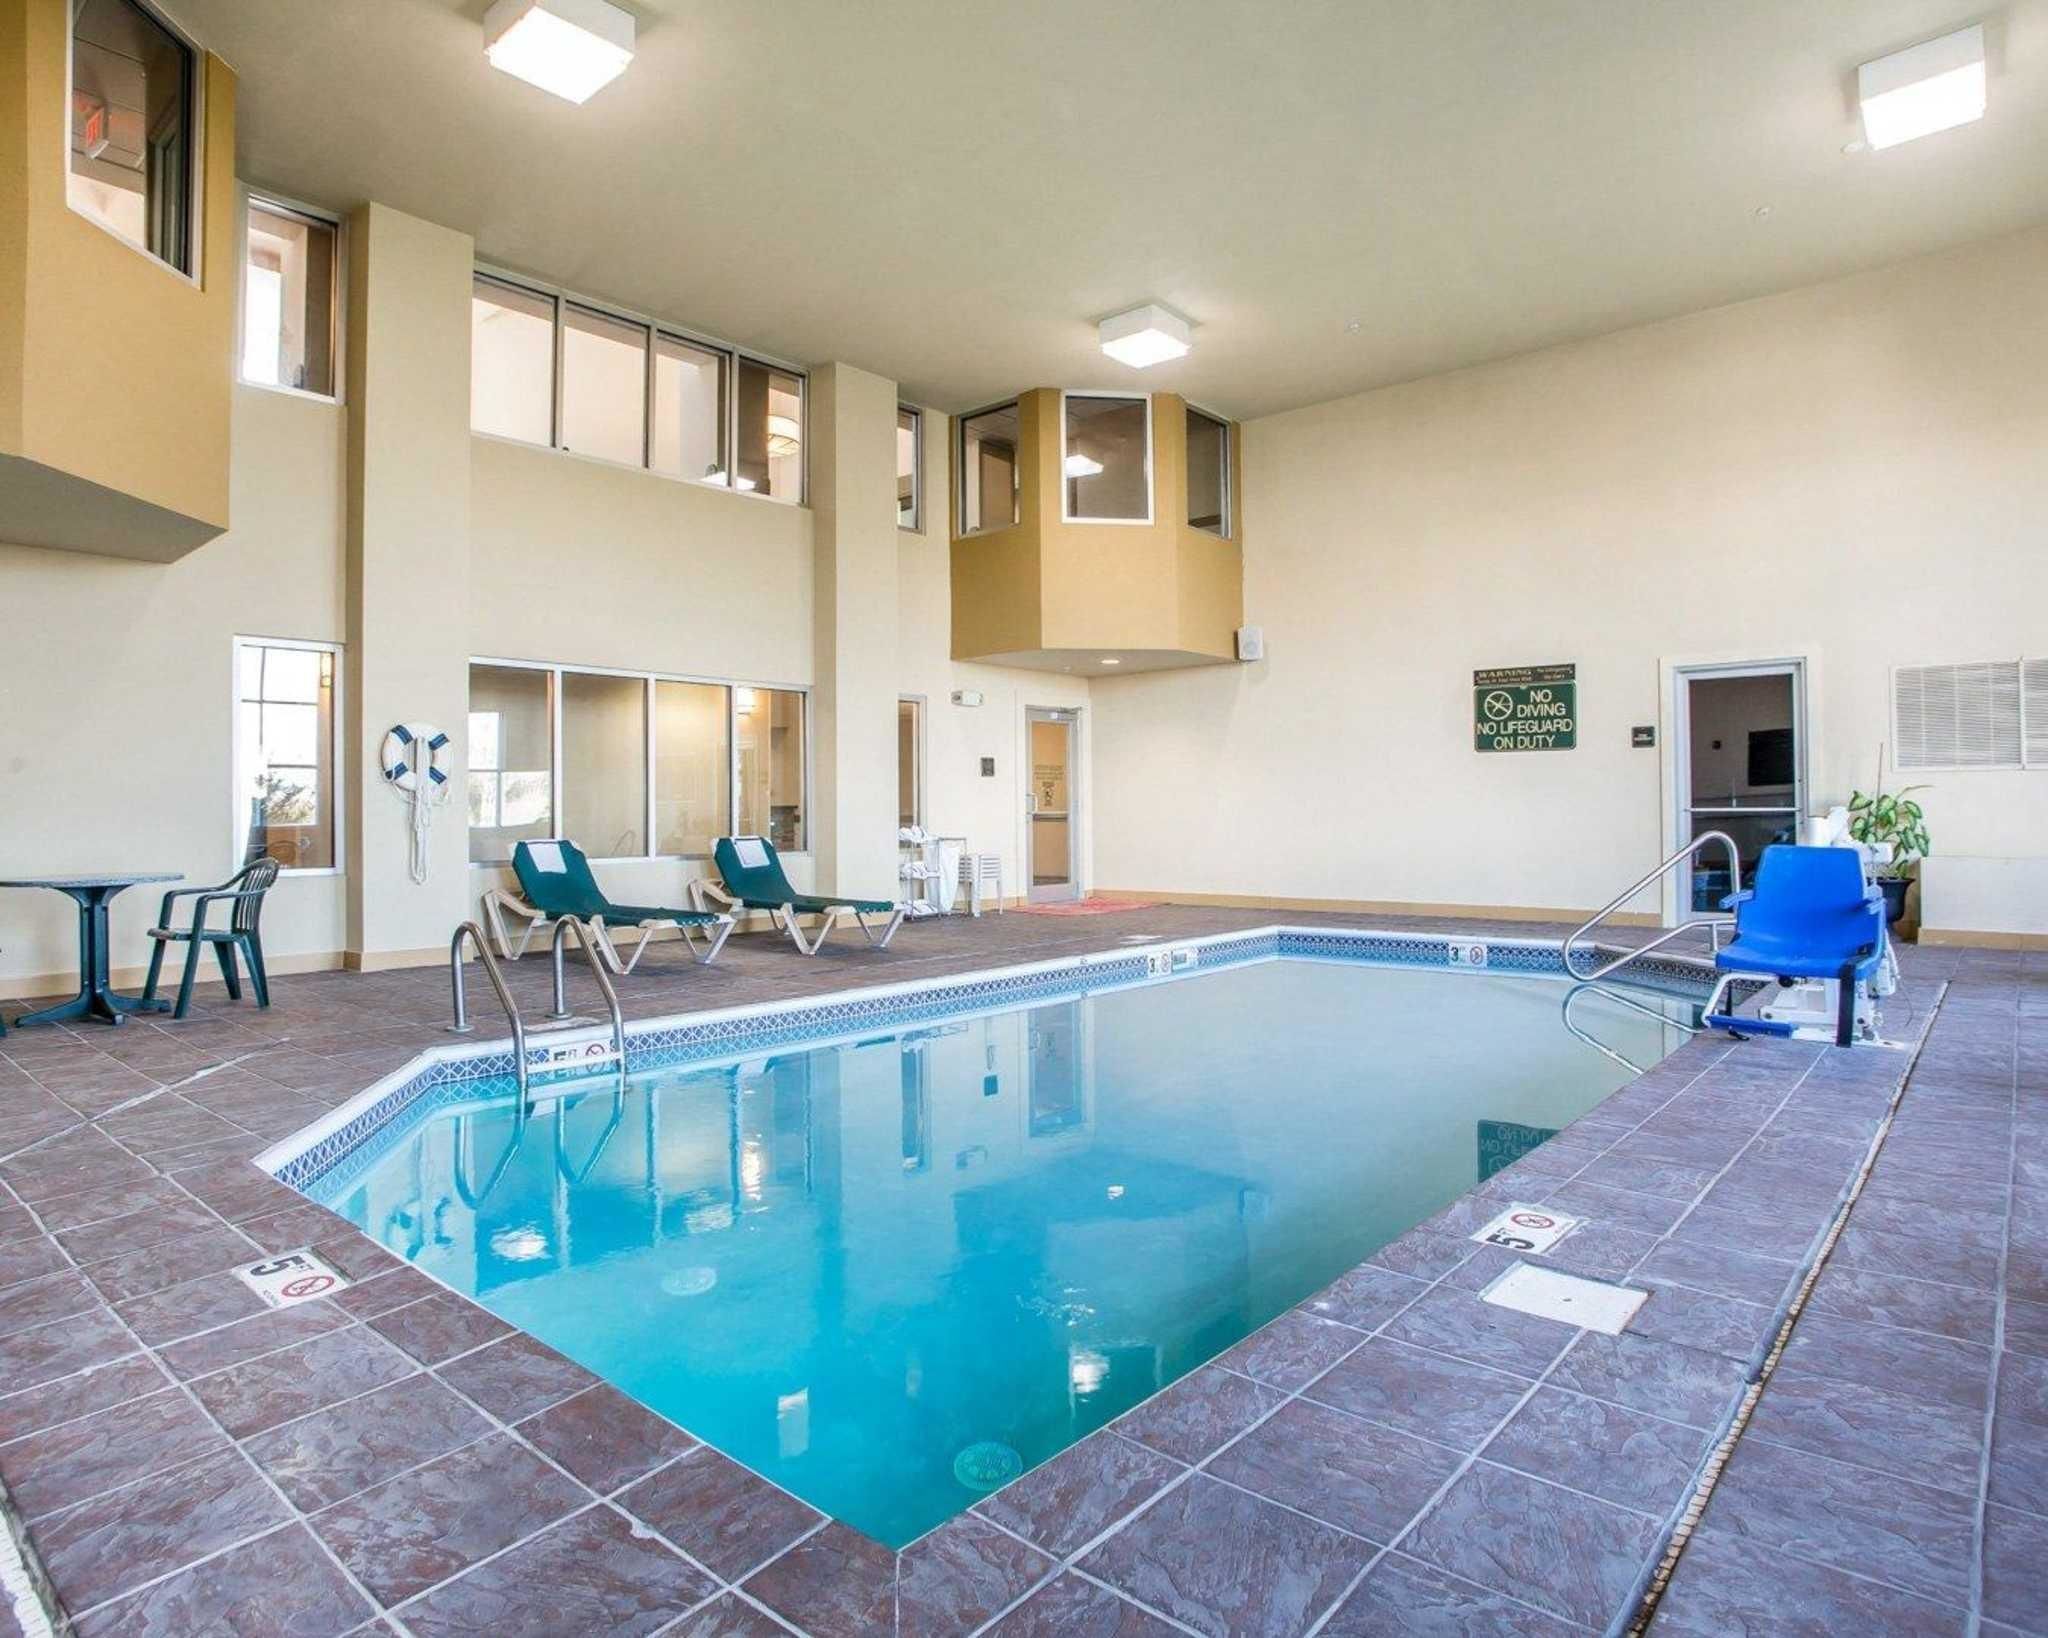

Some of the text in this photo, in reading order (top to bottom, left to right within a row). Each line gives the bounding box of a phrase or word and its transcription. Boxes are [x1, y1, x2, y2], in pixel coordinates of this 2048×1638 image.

[1530, 689, 1552, 703] NO
[1517, 702, 1566, 718] DIVING
[1477, 718, 1573, 735] NO LIFEGUARD
[1493, 735, 1556, 750] ON DUTY
[1486, 1233, 1535, 1250] 5
[250, 1255, 306, 1276] 5
